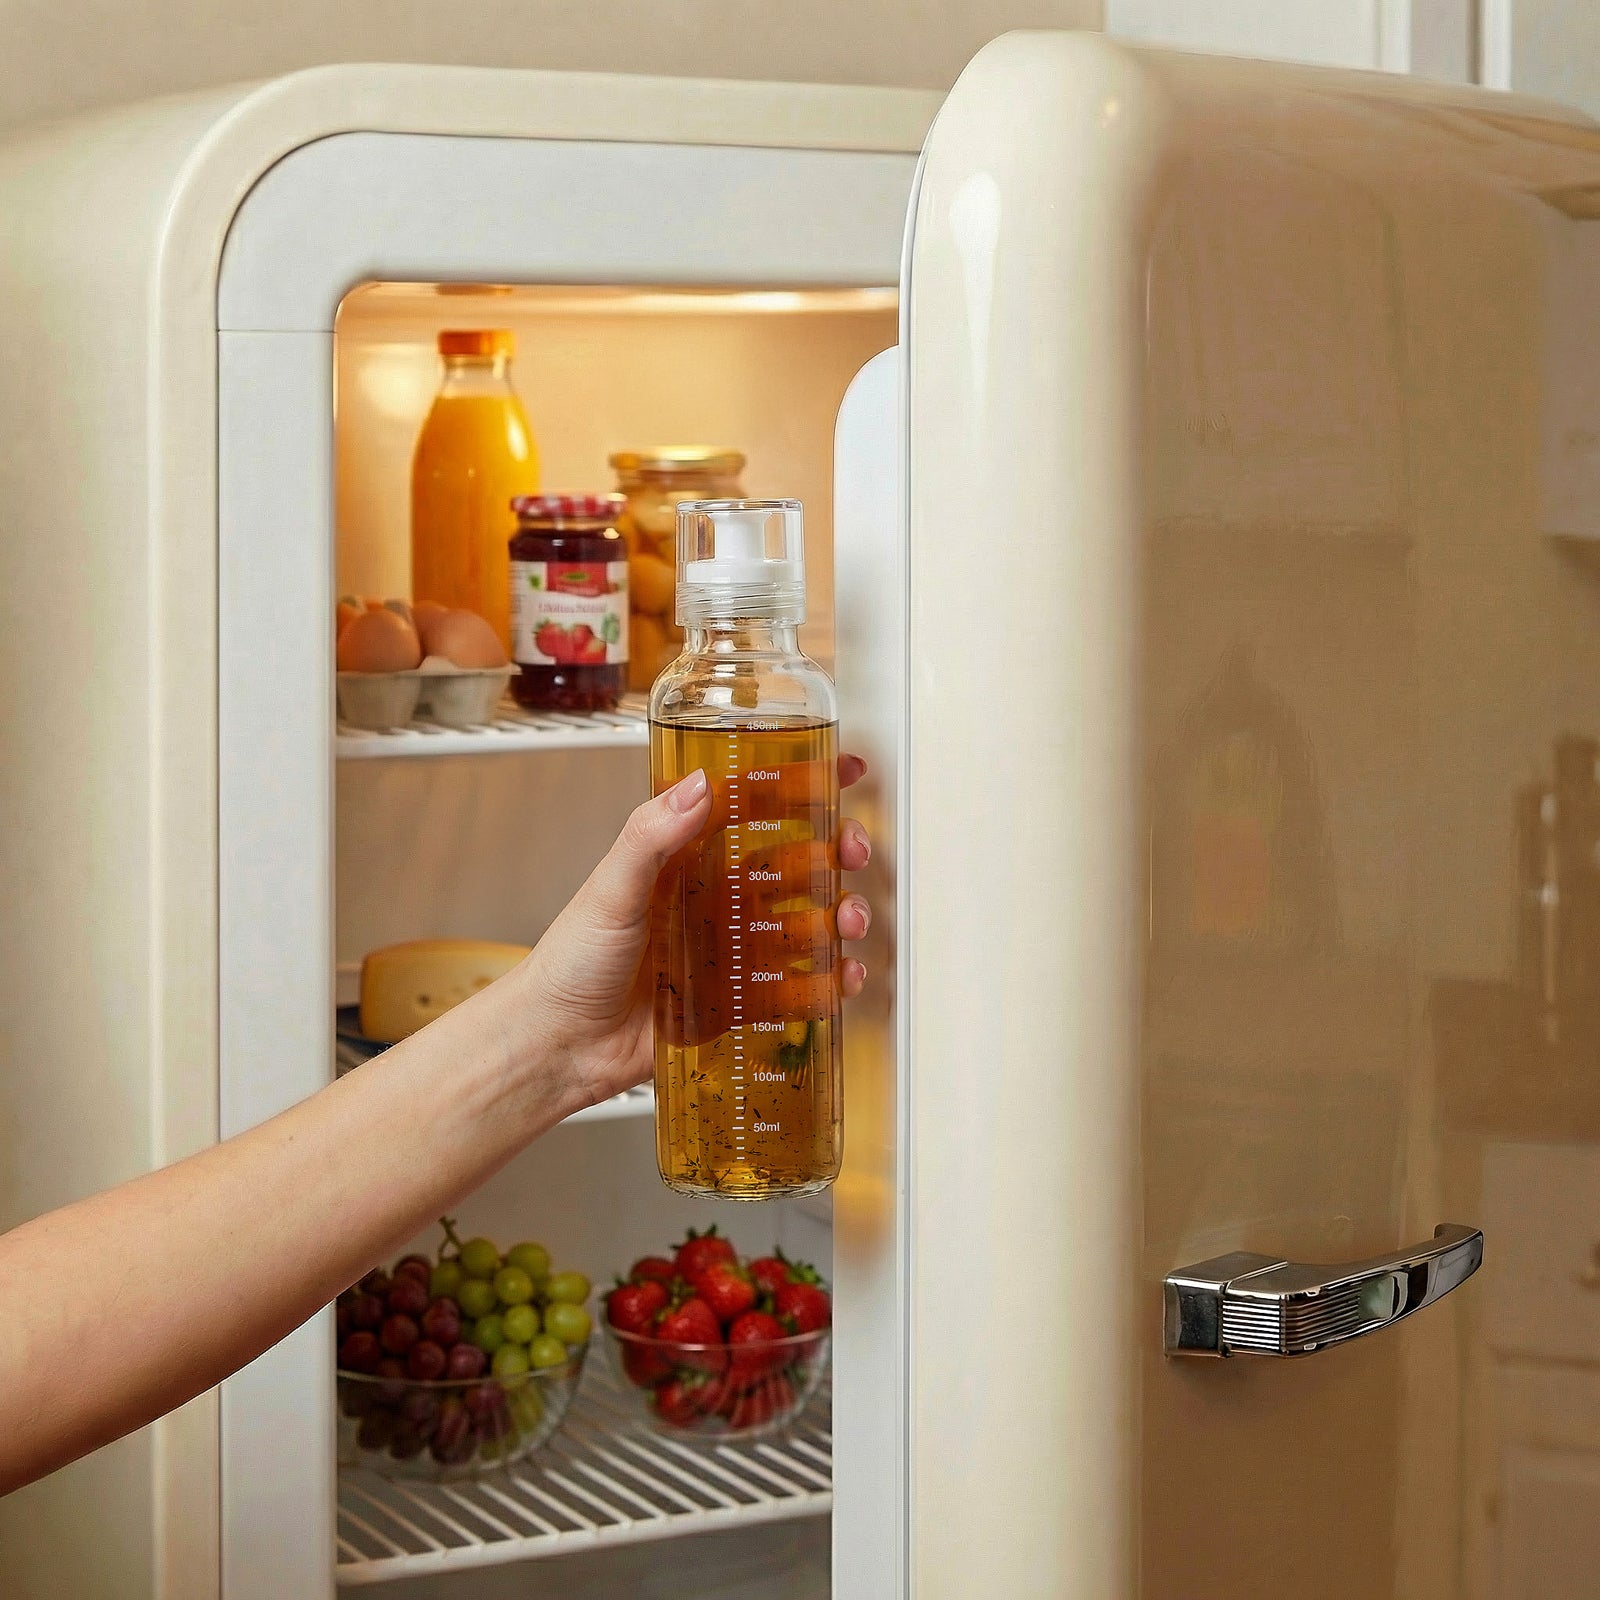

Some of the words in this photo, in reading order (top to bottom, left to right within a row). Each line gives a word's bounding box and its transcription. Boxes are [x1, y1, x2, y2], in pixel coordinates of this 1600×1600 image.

[746, 721, 779, 731] 450ml
[747, 770, 780, 781] 400ml
[748, 821, 781, 831] 350ml
[748, 871, 782, 882] 300ml
[749, 921, 783, 932] 250ml
[751, 971, 783, 982] 200ml
[752, 1022, 785, 1032] 150ml
[753, 1072, 786, 1082] 100ml
[753, 1122, 780, 1132] 50ml
